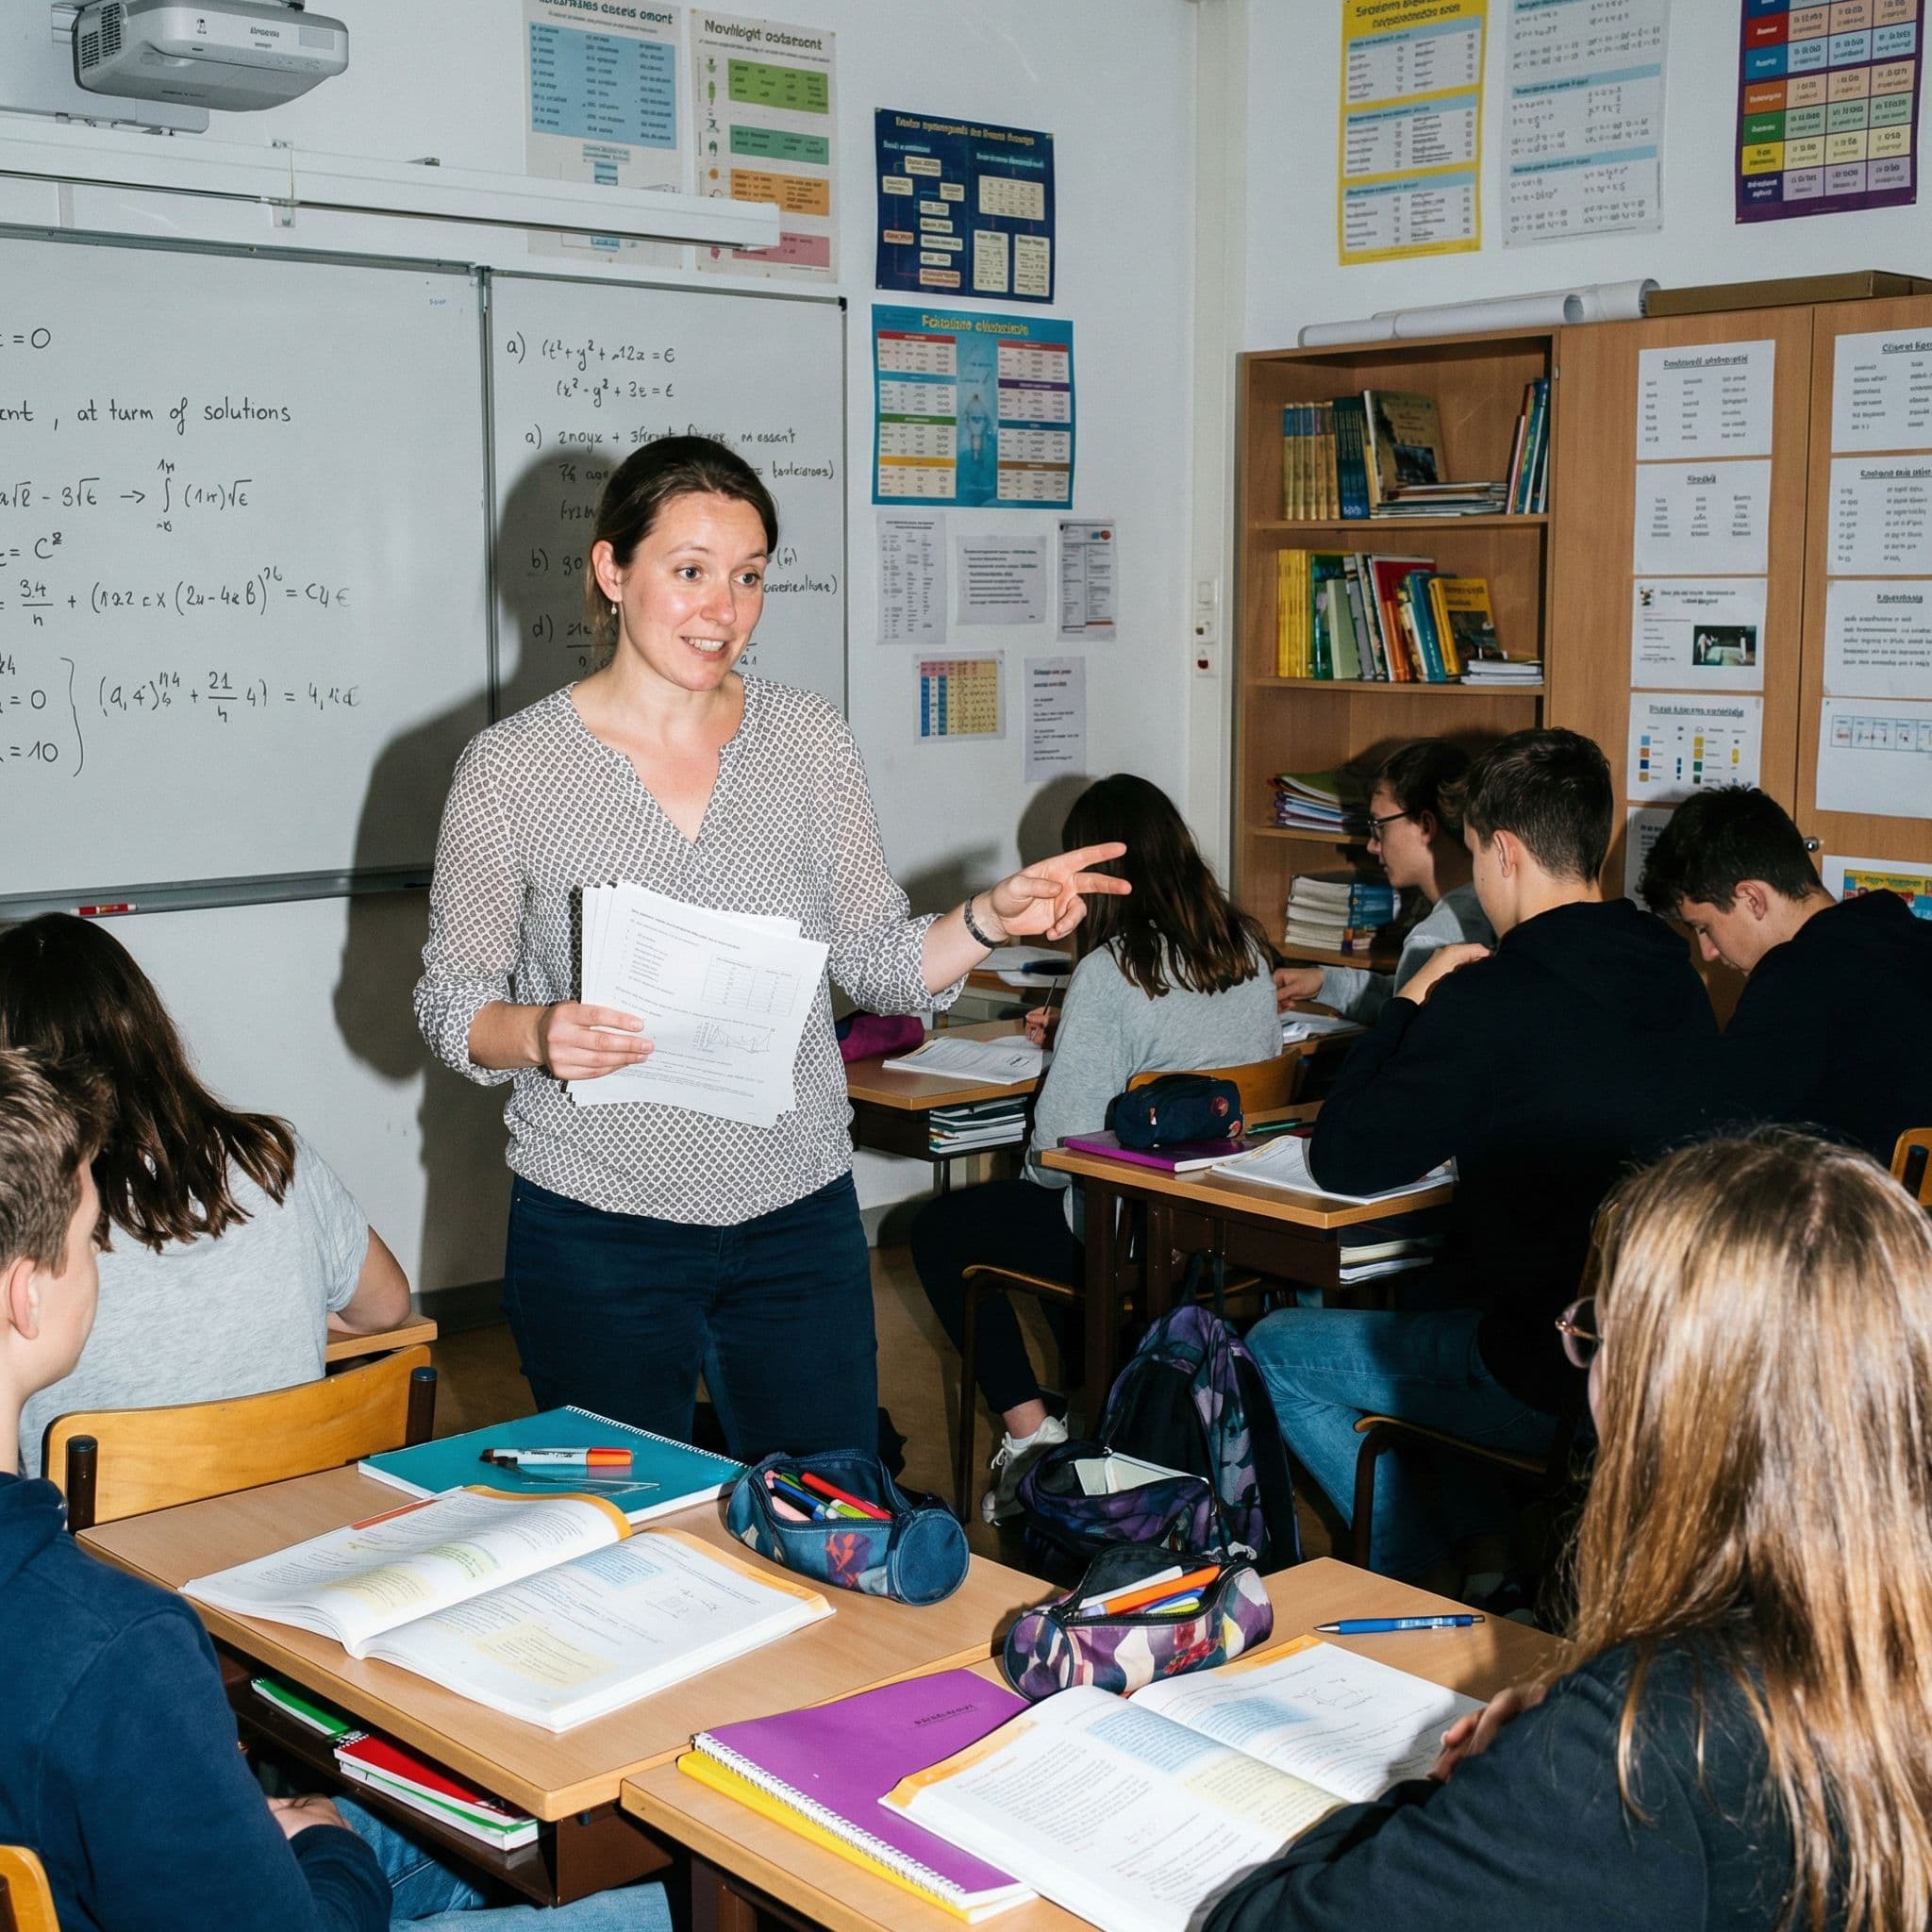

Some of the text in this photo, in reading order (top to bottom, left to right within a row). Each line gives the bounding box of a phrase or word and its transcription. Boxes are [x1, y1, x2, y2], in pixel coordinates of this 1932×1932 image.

[77, 398, 98, 422] at
[169, 396, 188, 436] of
[203, 395, 291, 423] solutions
